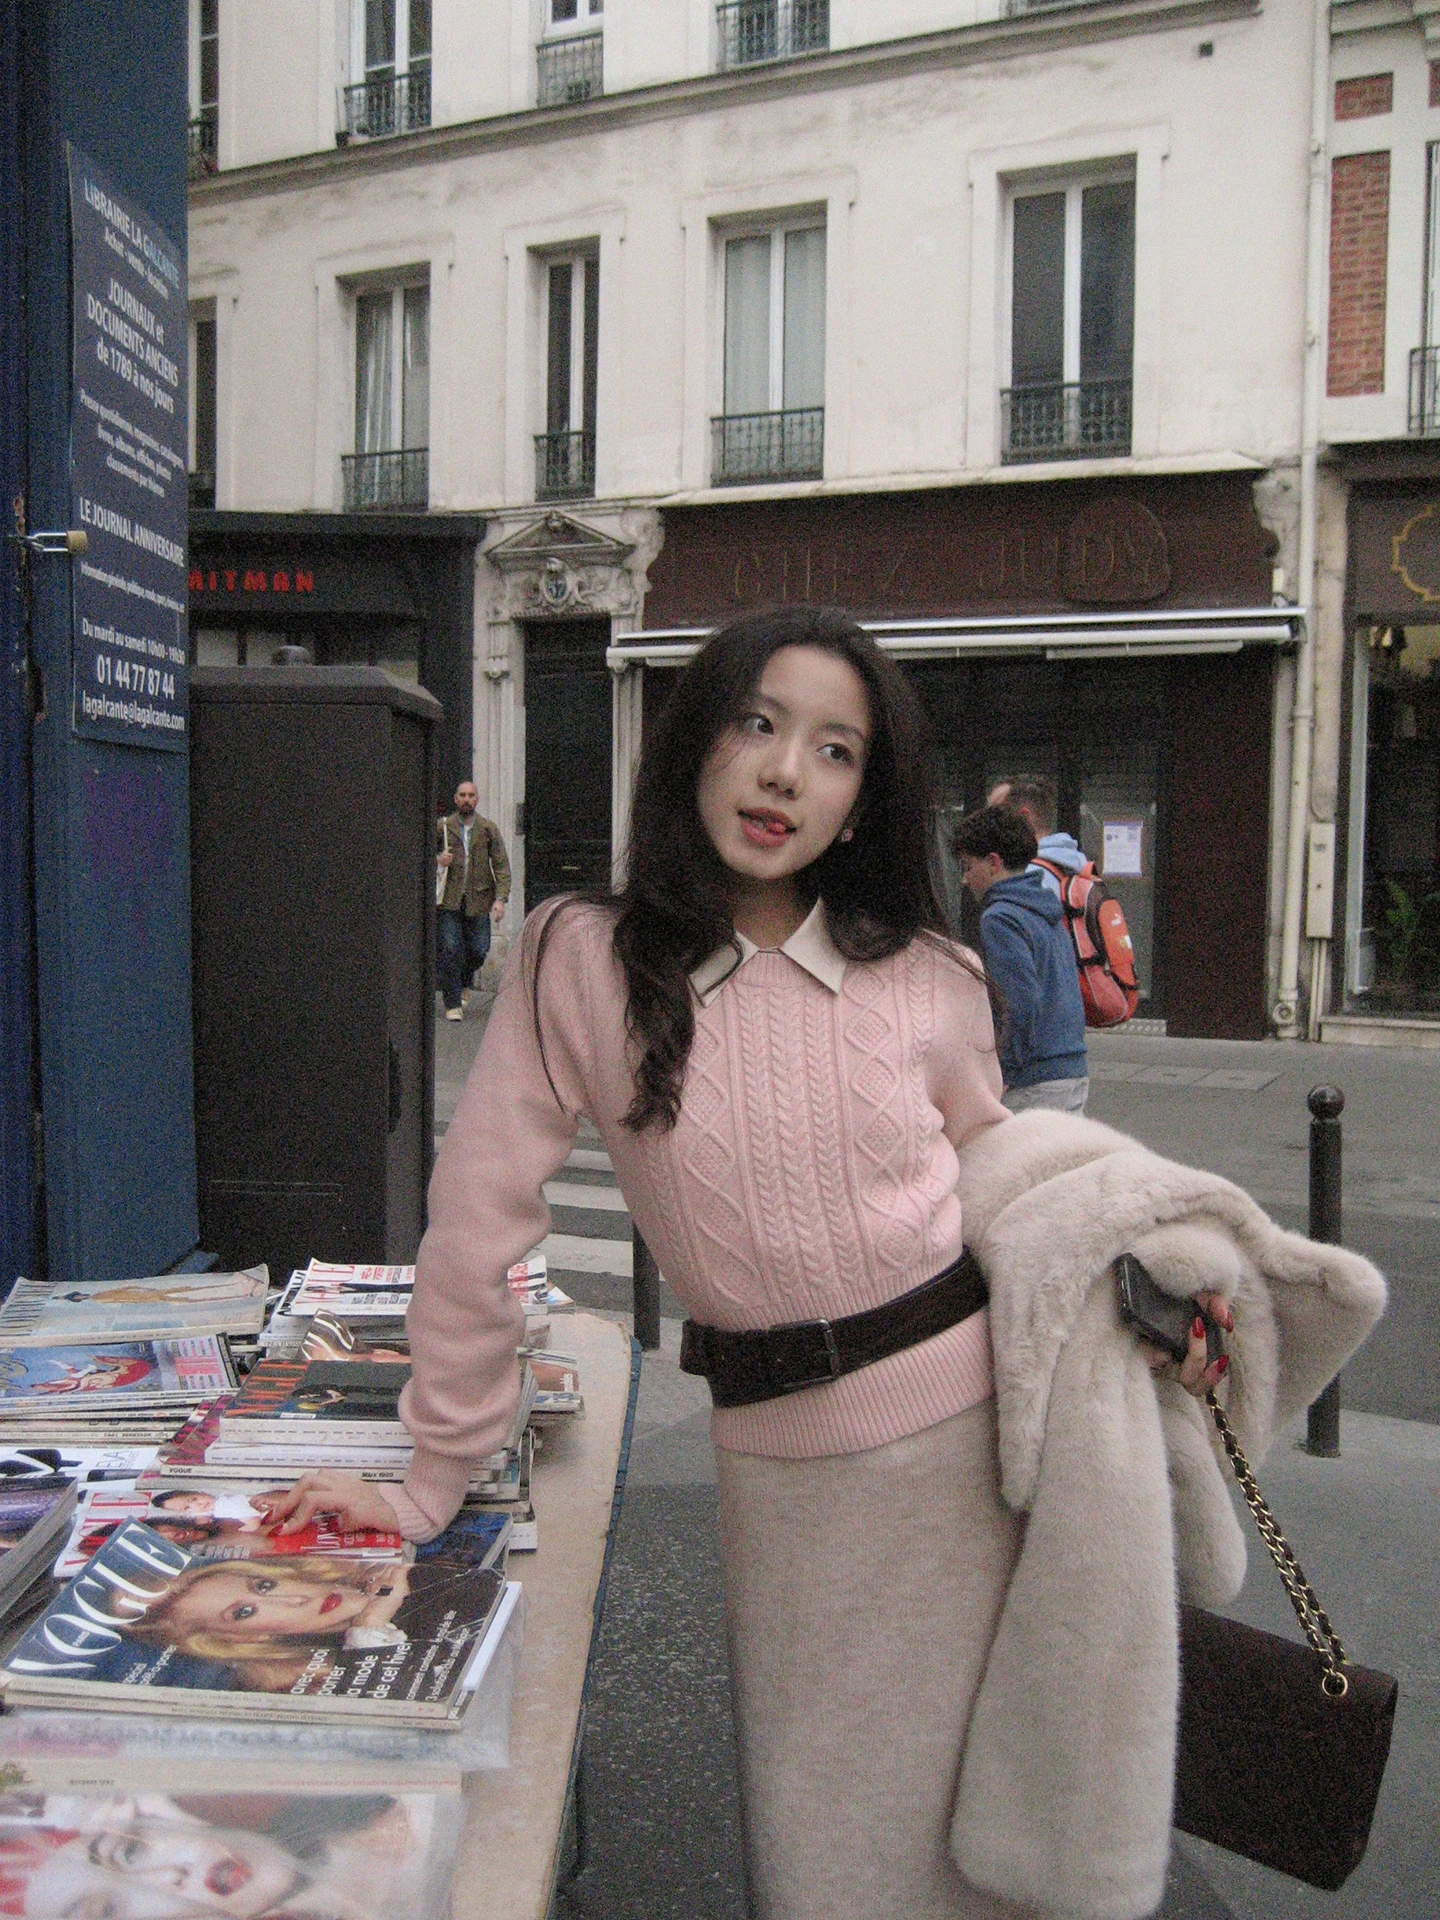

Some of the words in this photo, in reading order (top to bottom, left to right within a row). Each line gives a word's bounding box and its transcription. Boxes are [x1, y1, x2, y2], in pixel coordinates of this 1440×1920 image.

[84, 177, 130, 238] LIBRAIRIE
[131, 221, 143, 251] LA
[110, 277, 156, 337] JOURNAUX
[156, 324, 165, 346] et
[88, 293, 145, 360] DOCUMENTS
[145, 343, 179, 388] ANCIENS
[97, 336, 109, 366] de
[111, 346, 133, 382] 1789
[140, 374, 154, 400] nos
[154, 380, 174, 414] jours
[80, 496, 91, 523] LE
[92, 503, 134, 543] JOURNAL
[134, 522, 185, 568] ANNIVERSAIRE
[82, 617, 93, 637] Du
[94, 626, 115, 644] mardi
[115, 632, 124, 647] au
[125, 636, 147, 654] samedi
[97, 653, 112, 686] 01
[115, 659, 130, 690] 44
[131, 663, 146, 693] 77
[147, 667, 161, 697] 87
[162, 672, 175, 700] 44
[82, 690, 185, 731] lagalcante@lagalcante.com
[168, 1467, 193, 1475] VOGUE
[9, 1521, 193, 1672] VOGUE
[290, 1670, 316, 1694] avec
[307, 1648, 330, 1671] quoi
[317, 1665, 347, 1696] porter
[341, 1686, 361, 1699] la
[352, 1654, 379, 1688] mode
[366, 1681, 391, 1700] de
[380, 1659, 401, 1687] cet
